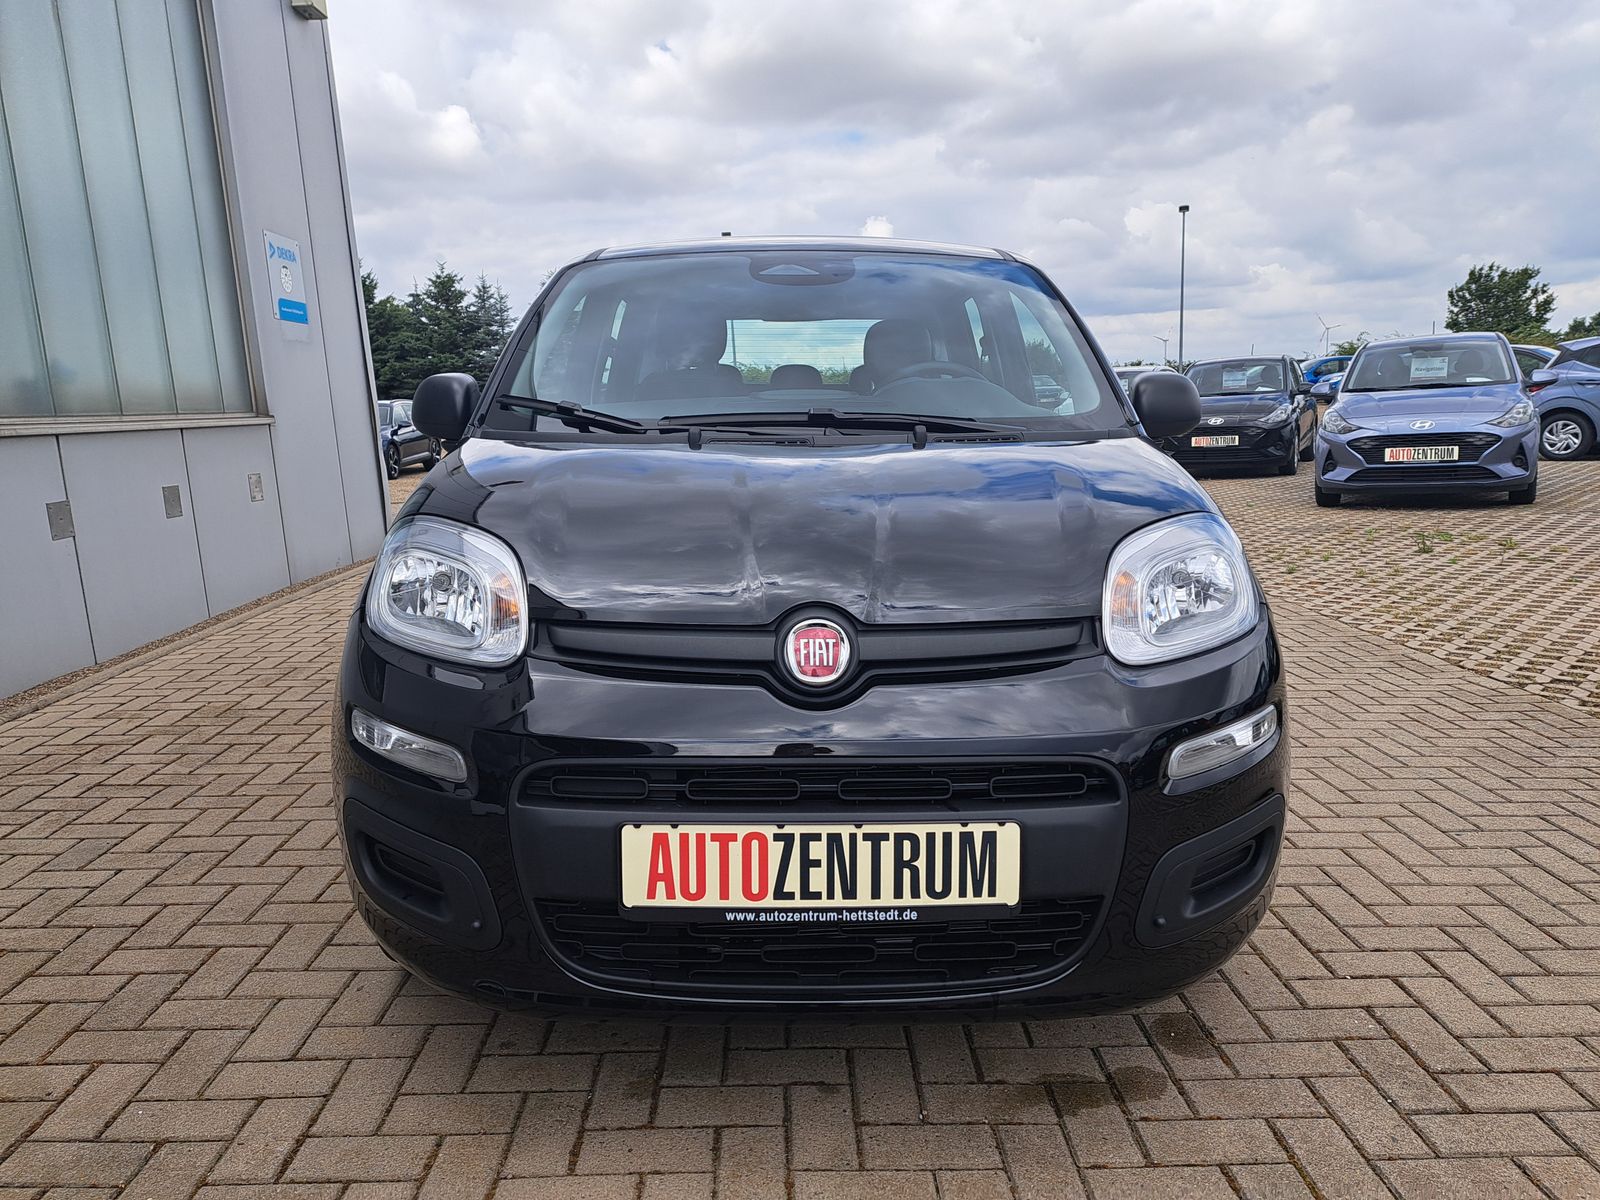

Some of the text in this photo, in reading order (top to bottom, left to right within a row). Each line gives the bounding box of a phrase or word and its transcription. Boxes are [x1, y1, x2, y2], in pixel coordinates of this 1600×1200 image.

[277, 246, 297, 263] DEKRA
[1194, 437, 1236, 446] AUTOZENTRUM
[1389, 447, 1455, 461] AUTOZENTRUM
[799, 638, 836, 666] FIAT
[646, 831, 997, 902] AUTOZENTRUM
[725, 909, 918, 922] www.autozentrum-hettstedt.de
